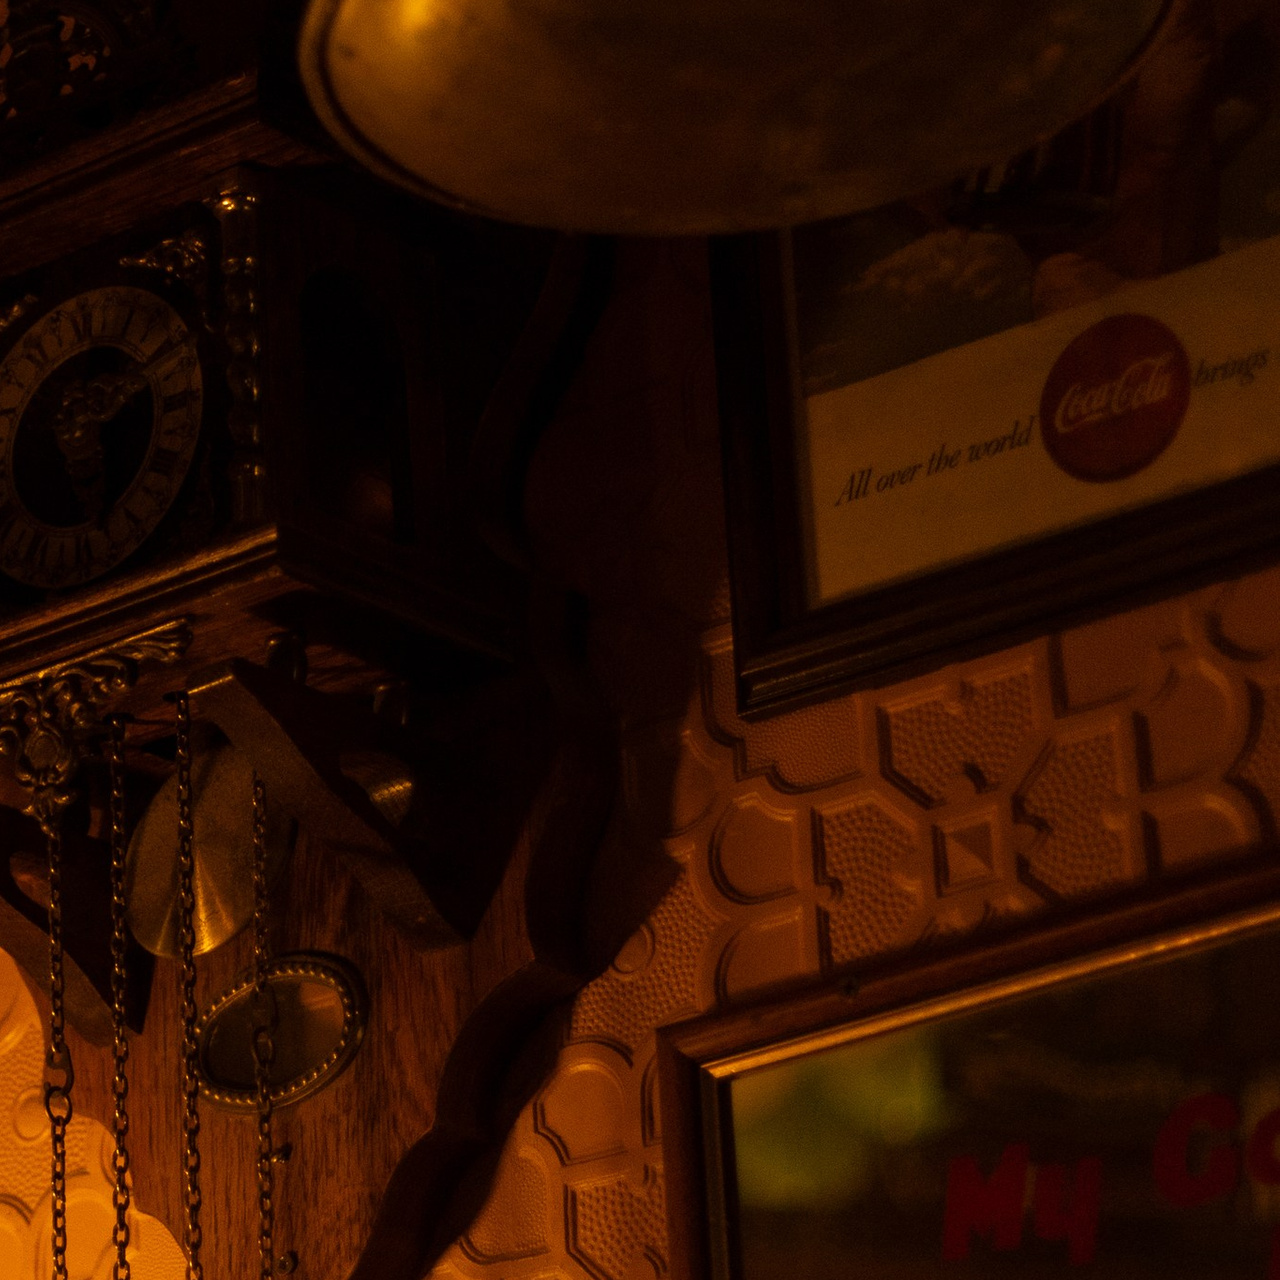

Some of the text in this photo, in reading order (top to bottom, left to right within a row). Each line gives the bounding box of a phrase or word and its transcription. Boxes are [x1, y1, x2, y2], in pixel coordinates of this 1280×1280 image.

[834, 465, 873, 507] All
[875, 463, 924, 493] over
[926, 442, 962, 478] the
[968, 414, 1037, 463] world
[942, 1142, 1102, 1267] My
